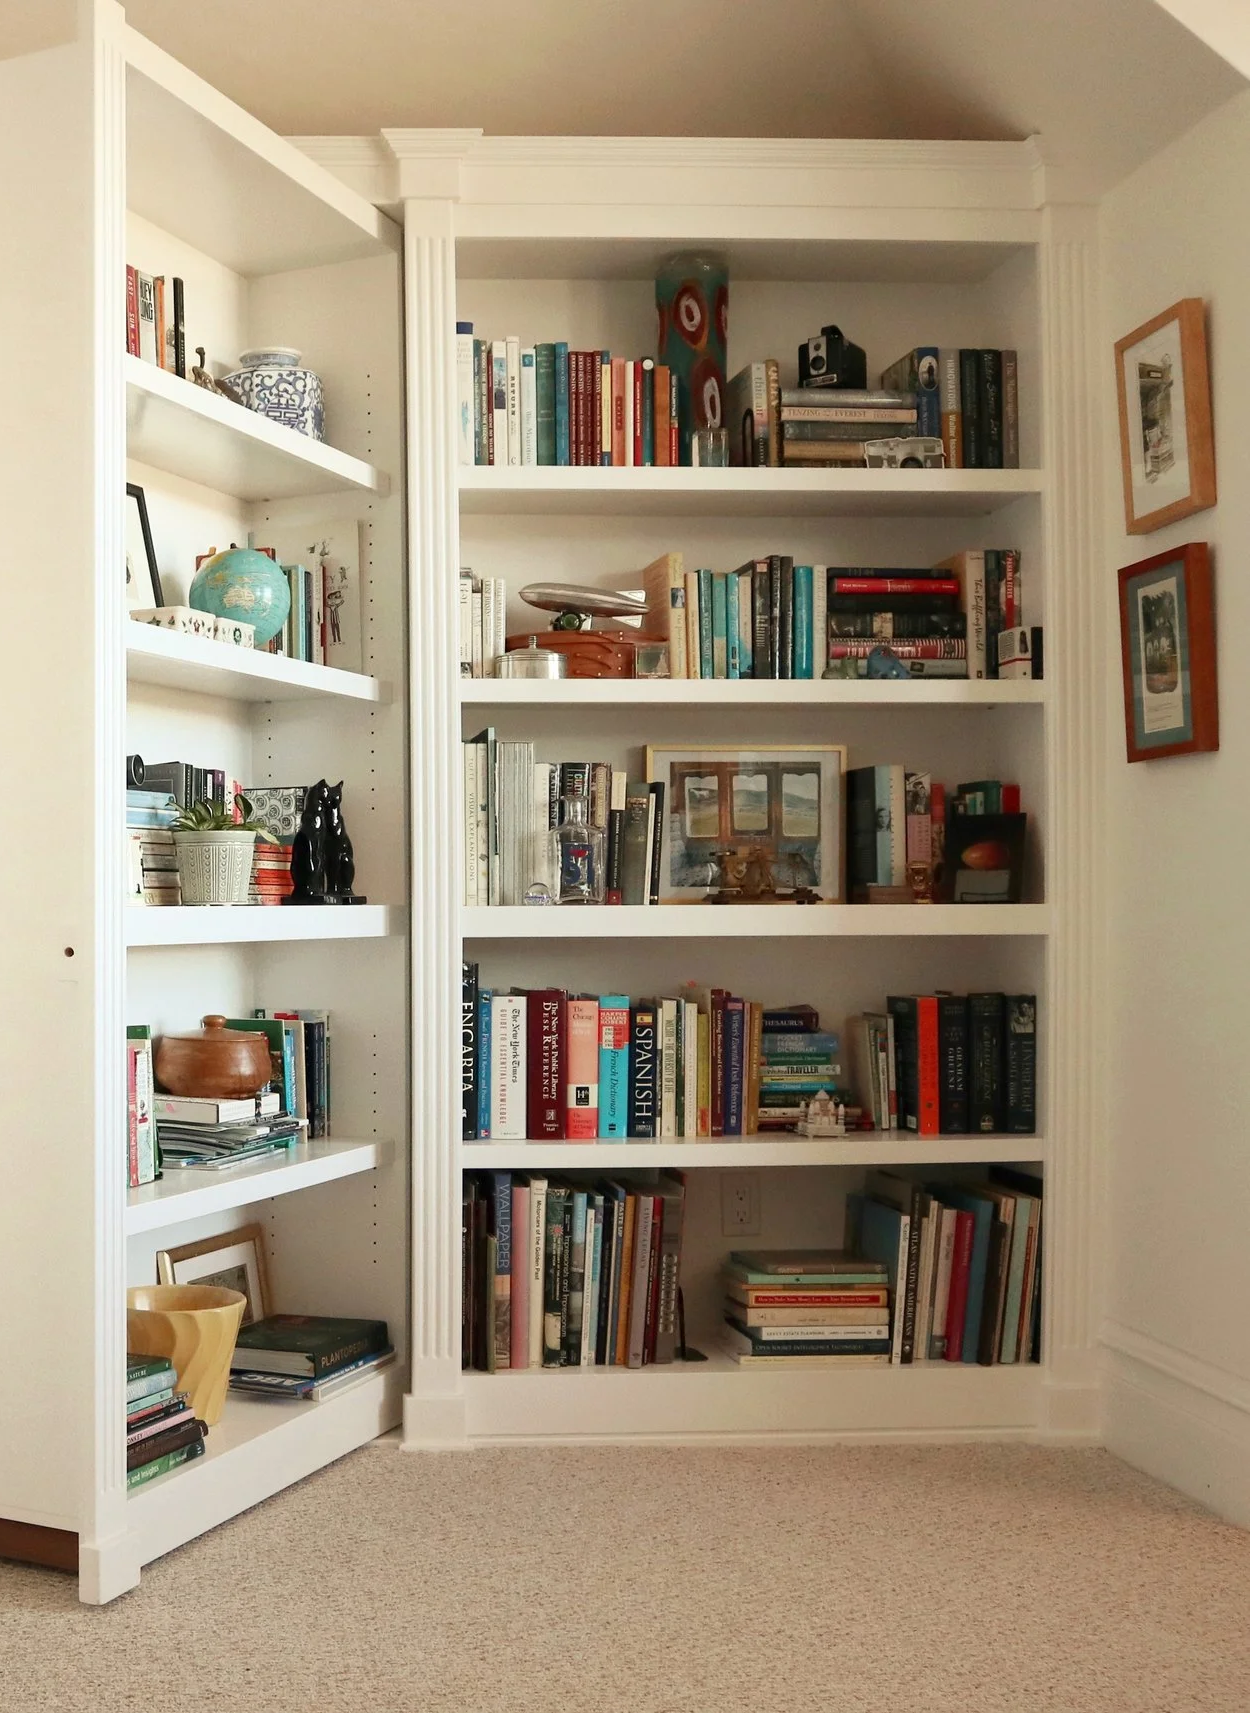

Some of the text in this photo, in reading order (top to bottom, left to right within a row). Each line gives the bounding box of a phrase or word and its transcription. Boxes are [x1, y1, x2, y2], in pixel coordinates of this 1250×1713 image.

[946, 359, 956, 410] INNOVATORS
[948, 414, 957, 437] Walter
[462, 1001, 475, 1091] ENCARTA
[499, 1008, 507, 1125] GUIDE TO ESSENTIAL KNOWLEDGE
[509, 1008, 520, 1083] The New York Times
[543, 1001, 552, 1100] DESK REFERENCE
[549, 1001, 559, 1100] The New York Public Library
[635, 1027, 653, 1117] SPANISH
[731, 1067, 740, 1081] Desk
[787, 1066, 819, 1074] TRAVELLER
[608, 1050, 619, 1118] French Dictionary
[731, 1083, 740, 1113] Reference
[497, 1183, 510, 1269] WALLPAPER
[534, 1200, 542, 1228] Motorcars
[533, 1267, 541, 1280] Past
[561, 1235, 571, 1337] Impressionists and Impressionism
[905, 1230, 919, 1336] ATLAS NATIVE AMERICANS
